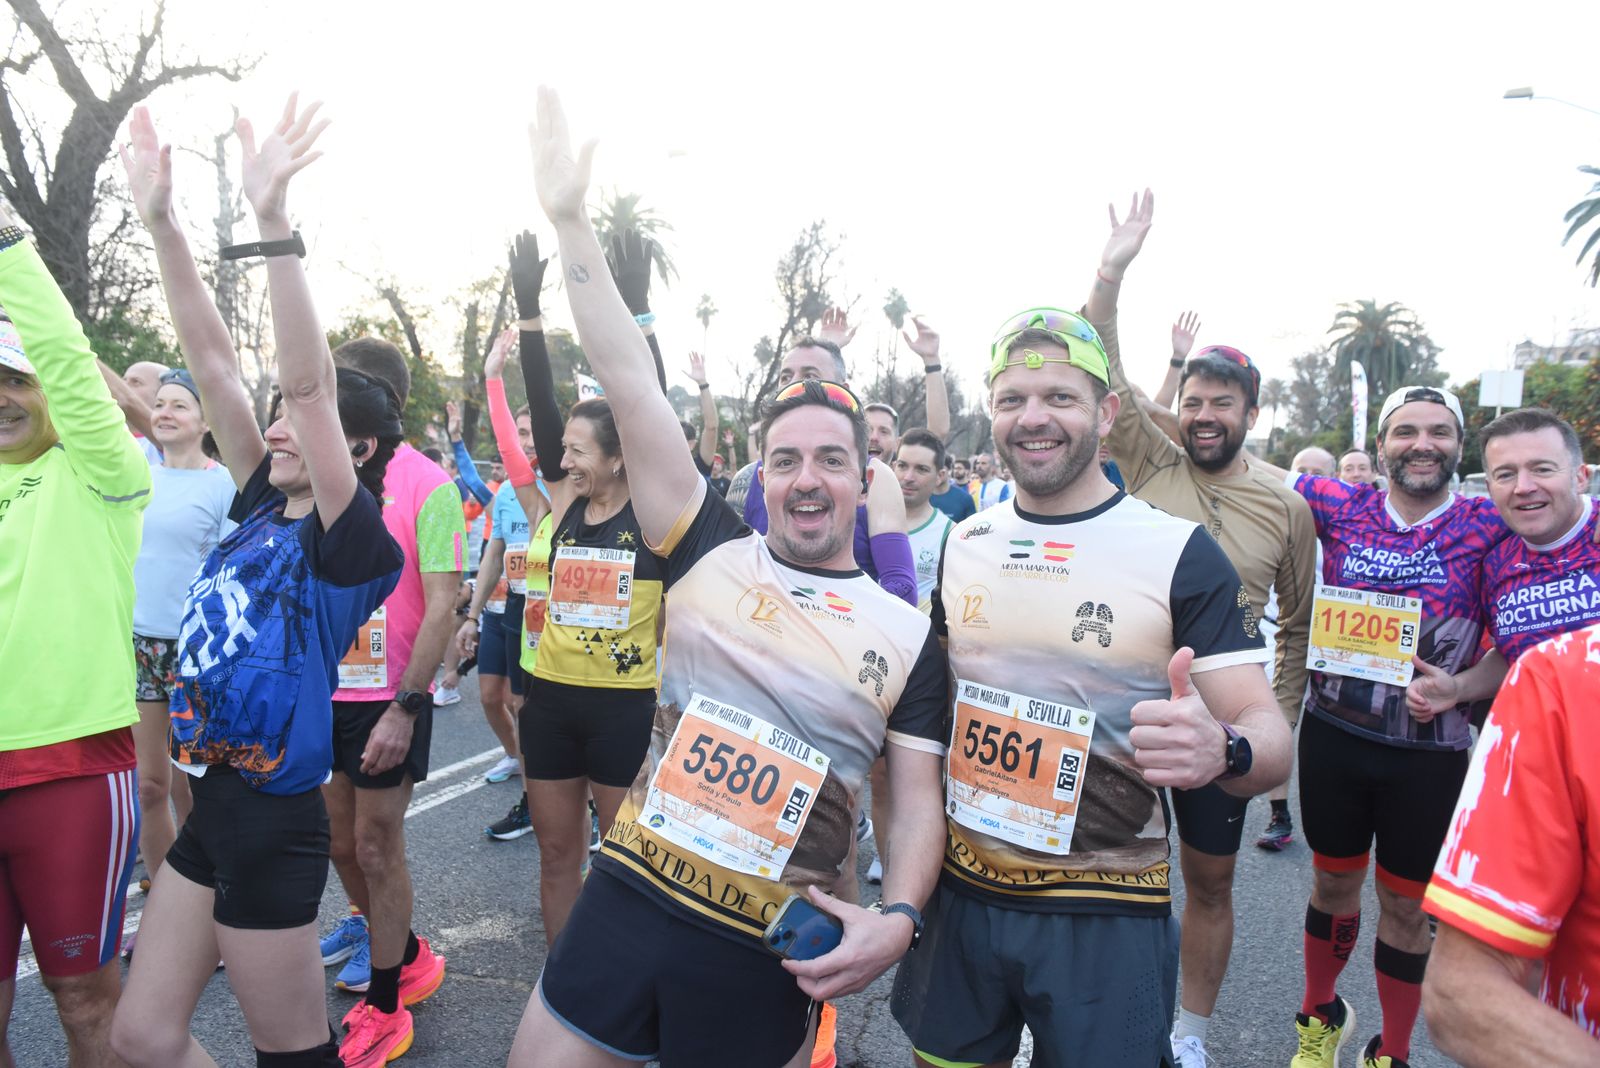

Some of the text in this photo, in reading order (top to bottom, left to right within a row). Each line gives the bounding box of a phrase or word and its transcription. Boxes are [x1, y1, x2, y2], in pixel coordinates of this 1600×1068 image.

[599, 549, 623, 560] SEVILLA
[1349, 543, 1441, 566] CARRERA
[561, 565, 611, 591] 4977
[1497, 574, 1597, 610] CARRERA
[1321, 588, 1406, 609] MEDIO MARATÓN SEVILLA
[1496, 591, 1600, 627] NOCTURNA
[1321, 607, 1400, 643] 11205
[1518, 622, 1551, 632] Corazón
[1565, 615, 1581, 623] Los
[964, 685, 1072, 728] MEDIO MARATÓN SEVILLA
[697, 699, 811, 764] MEDIO MARATÓN SEVILLA
[963, 718, 1043, 781] 5561
[683, 733, 780, 806] 5580
[721, 792, 742, 808] Paula
[979, 816, 1001, 830] HOKA
[692, 831, 714, 852] HOKA
[719, 883, 757, 915] DE
